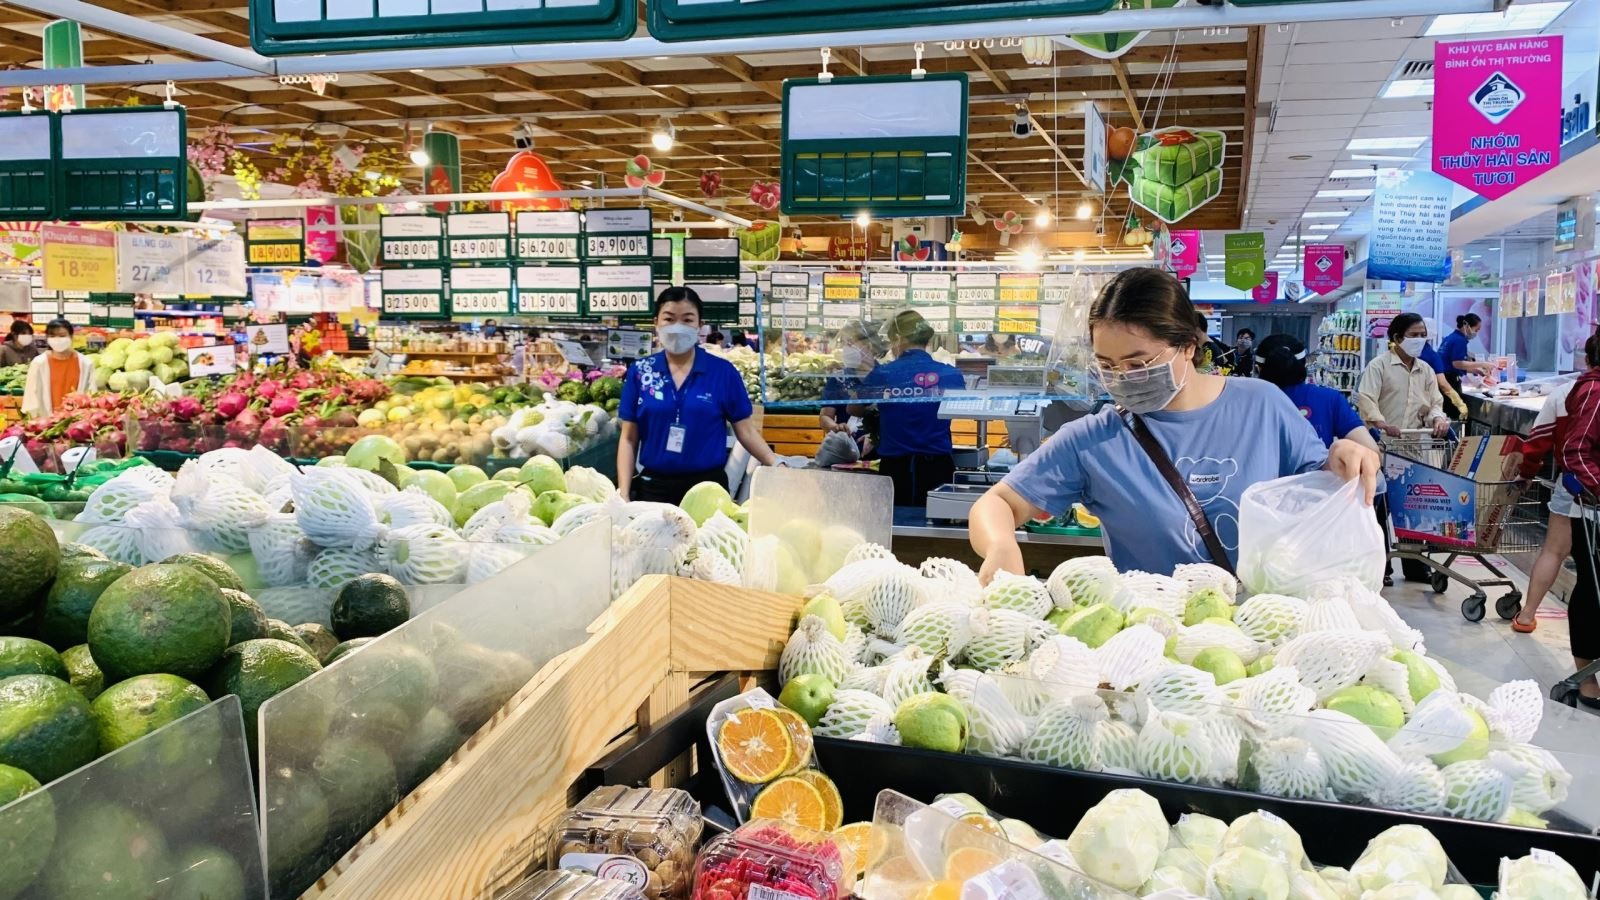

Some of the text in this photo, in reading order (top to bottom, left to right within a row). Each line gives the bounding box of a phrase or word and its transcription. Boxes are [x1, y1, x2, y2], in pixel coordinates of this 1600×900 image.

[1448, 46, 1470, 55] KHU
[1471, 43, 1494, 54] VỰC
[1519, 40, 1549, 49] HÀNG
[1445, 58, 1469, 69] BÌNH
[1488, 57, 1504, 67] THỊ
[1505, 54, 1551, 65] TRƯỜNG
[1471, 132, 1520, 150] NHÓM
[1439, 148, 1551, 169] THỦY HẢI SẢN
[1473, 171, 1515, 186] TƯƠI
[386, 243, 427, 255] 48.800
[452, 241, 495, 254] 48.900
[520, 240, 565, 253] 56.200
[589, 238, 636, 253] 39.900
[592, 295, 638, 308] 56.300
